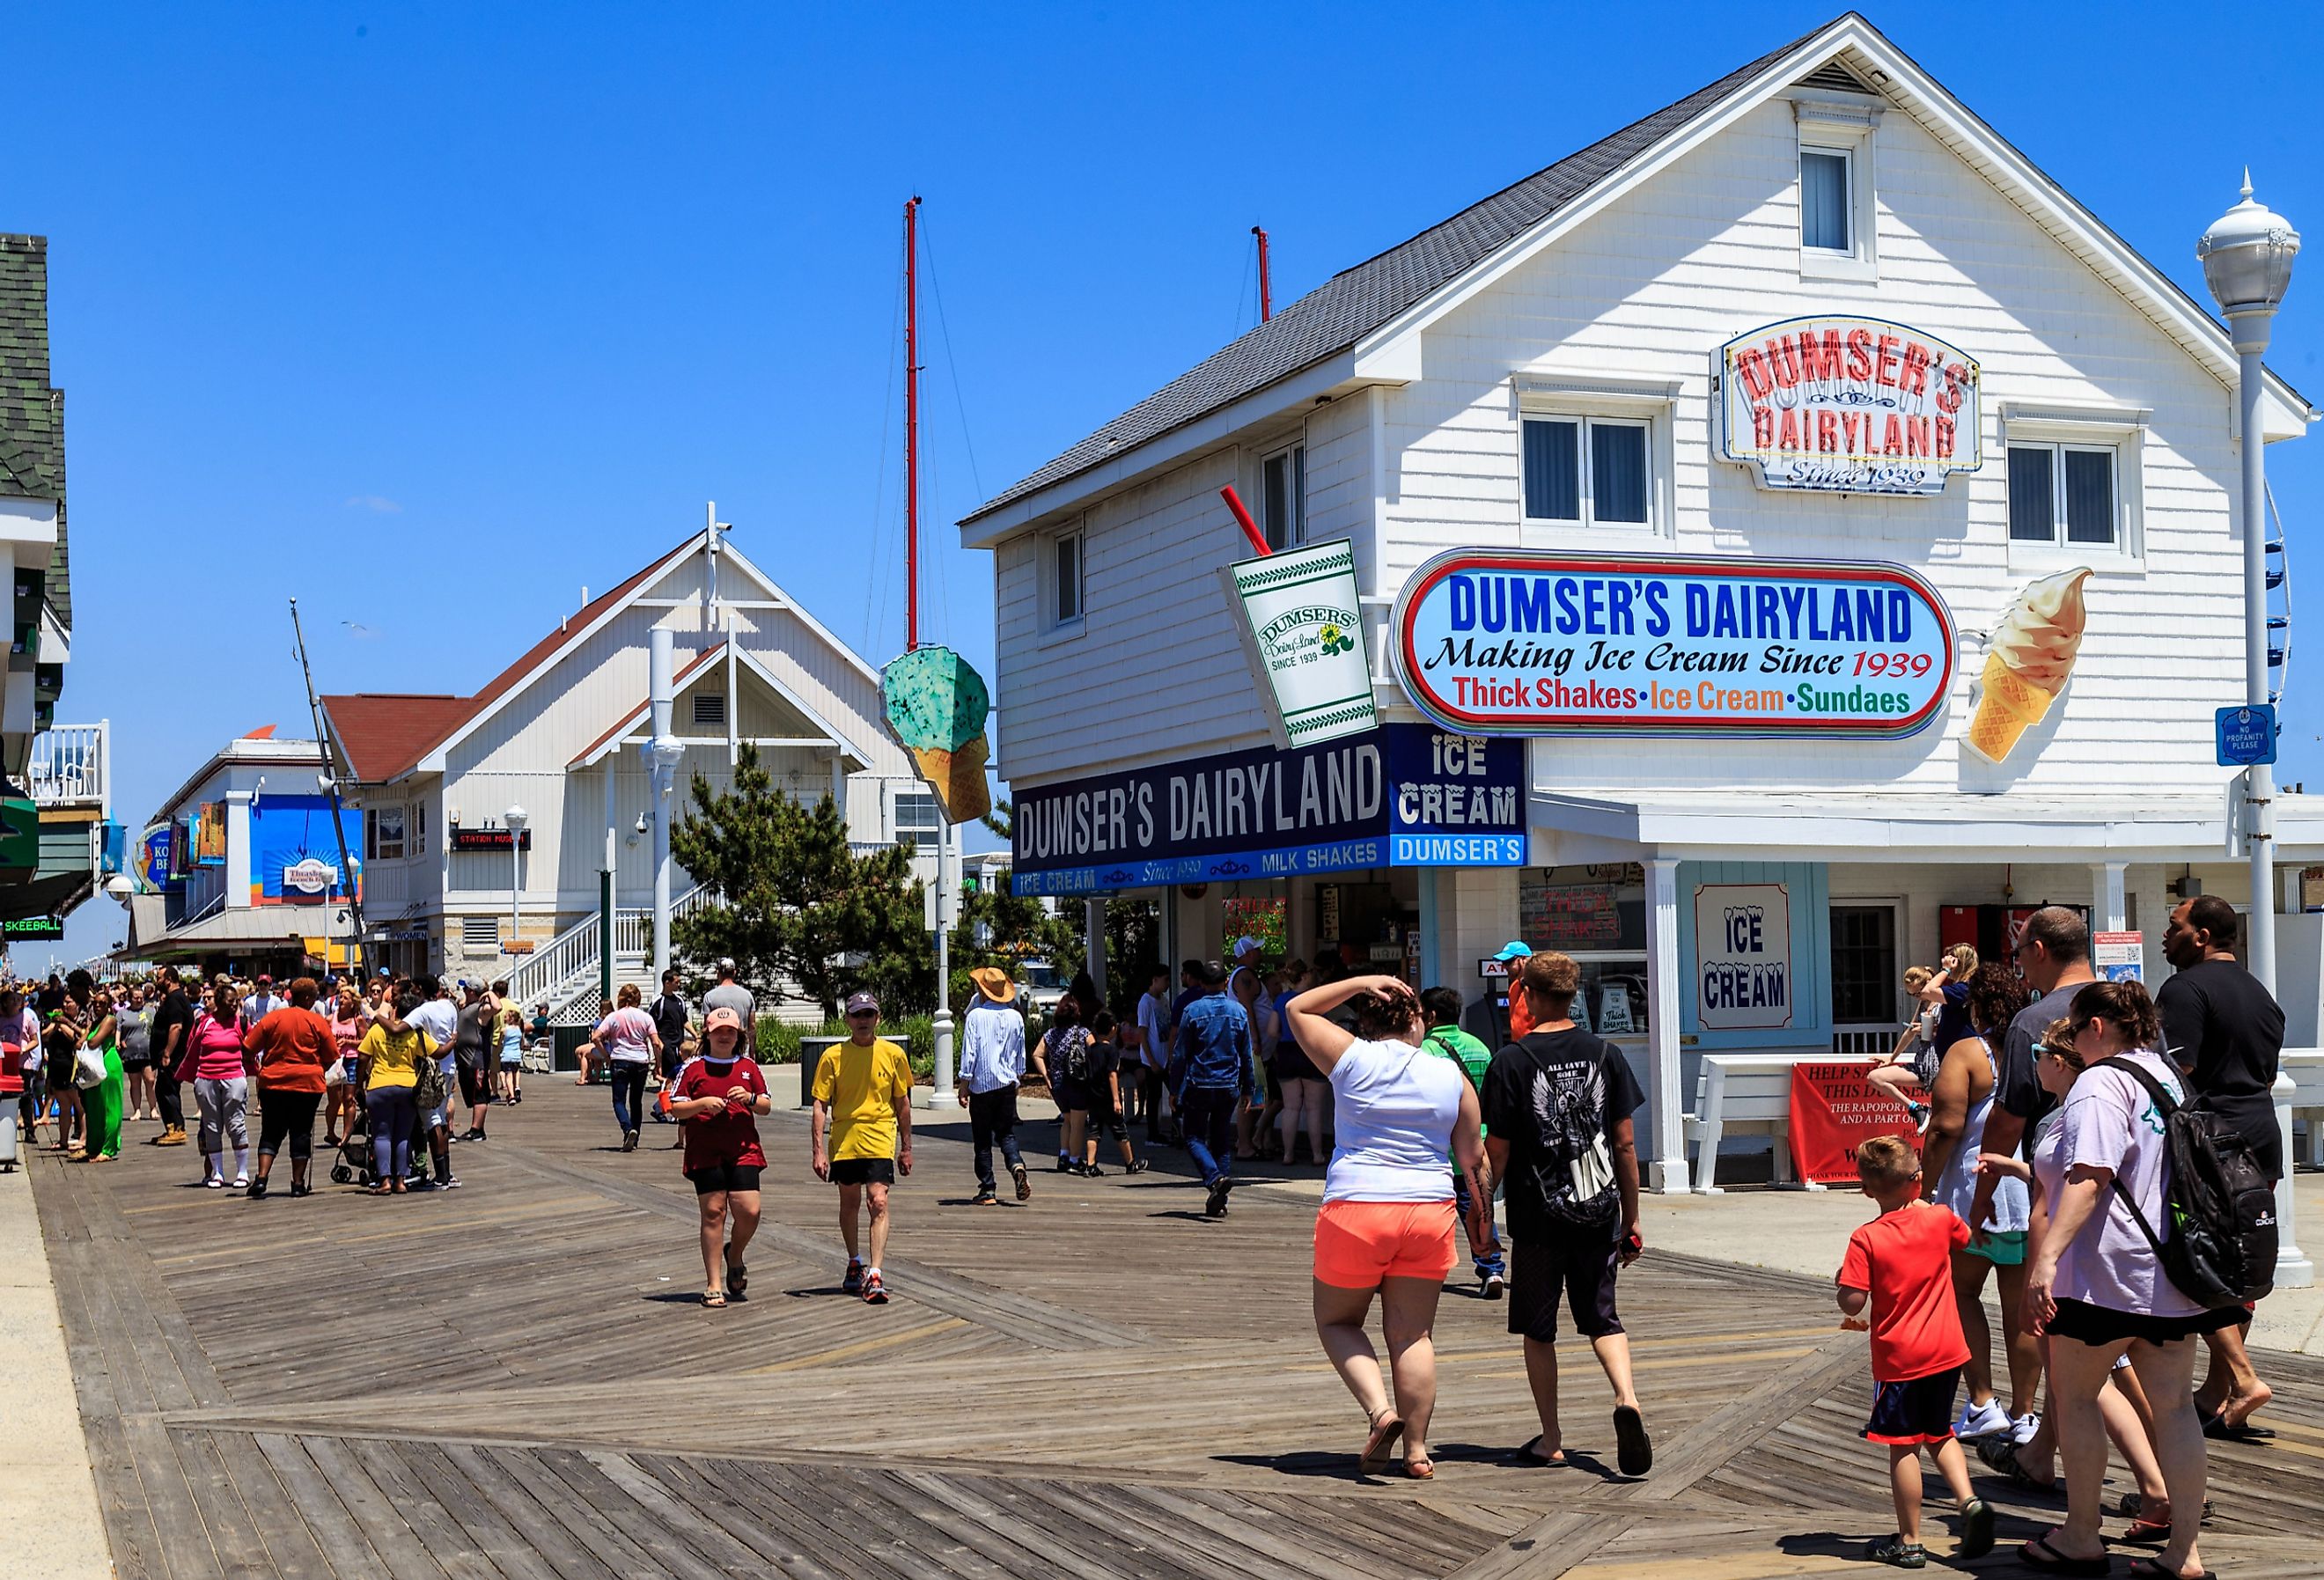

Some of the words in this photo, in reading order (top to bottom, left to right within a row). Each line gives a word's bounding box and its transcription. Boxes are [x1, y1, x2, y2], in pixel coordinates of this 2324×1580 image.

[1735, 327, 1970, 414] DUMSER'S
[1753, 405, 1956, 459] DAIRYLAND
[1791, 460, 1862, 485] Since
[1865, 467, 1926, 486] 1939
[1450, 574, 1669, 638] DUMSER'S
[1686, 580, 1912, 643] DAIRYLAND
[1261, 606, 1357, 643] DUMSERS'
[1271, 657, 1297, 672] SINCE
[1299, 652, 1318, 665] 1939
[1423, 637, 1576, 676] Making
[1584, 640, 1633, 673] Ice
[1644, 642, 1759, 674] Cream
[1763, 643, 1845, 675] Since
[1851, 650, 1934, 680] 1939
[1452, 676, 1530, 709] Thick
[1536, 678, 1637, 710] Shakes
[1650, 680, 1692, 710] Ice
[1697, 681, 1785, 712] Cream
[1797, 682, 1910, 714] Sundaes
[2226, 733, 2264, 742] PROFANITY
[2232, 740, 2259, 750] PLEASE
[1431, 733, 1489, 775] ICE
[1019, 778, 1154, 860] DUMSER'S
[1170, 743, 1382, 841] DAIRYLAND
[1398, 782, 1517, 825] CREAM
[460, 834, 491, 843] STATION
[1399, 838, 1520, 861] DUMSER'S
[1019, 872, 1041, 893] ICE
[1047, 869, 1095, 892] CREAM
[1143, 862, 1173, 881] Since
[1262, 852, 1298, 872] MILK
[1307, 842, 1378, 869] SHAKES
[4, 920, 62, 932] SKEEBALL
[396, 931, 427, 940] WOMEN
[1724, 905, 1764, 954] ICE
[1486, 964, 1507, 973] AT
[1703, 960, 1785, 1010] CREAM
[1548, 1063, 1563, 1072] ALL
[1808, 1066, 1850, 1081] HELP
[1824, 1084, 1859, 1099] THIS
[1830, 1103, 1850, 1113] THE
[1841, 1115, 1863, 1124] AND
[1864, 1115, 1872, 1124] A
[1874, 1114, 1901, 1124] PART
